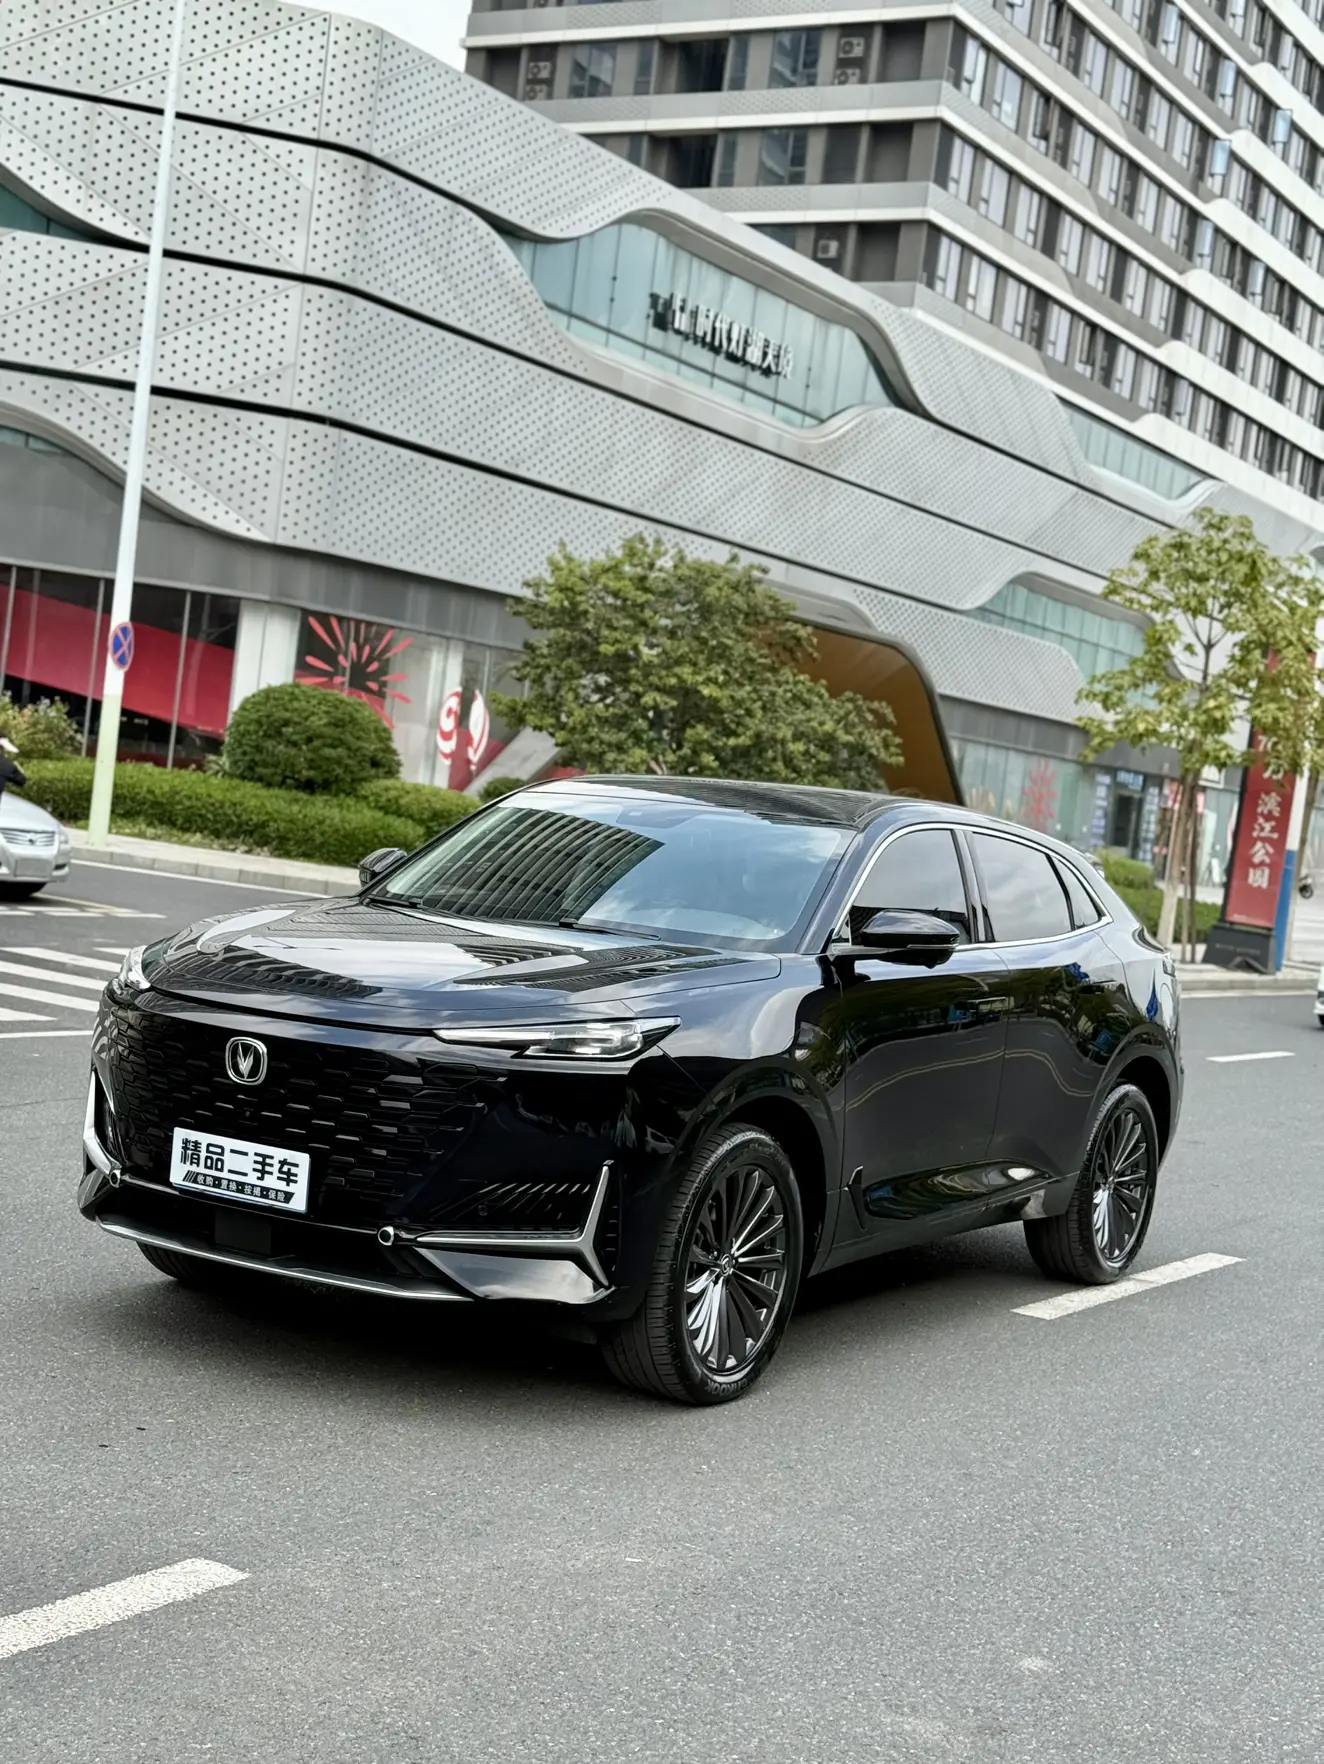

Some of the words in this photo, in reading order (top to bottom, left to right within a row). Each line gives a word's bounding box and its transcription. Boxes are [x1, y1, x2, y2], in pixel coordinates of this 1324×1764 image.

[180, 1137, 300, 1187] 精品二手车
